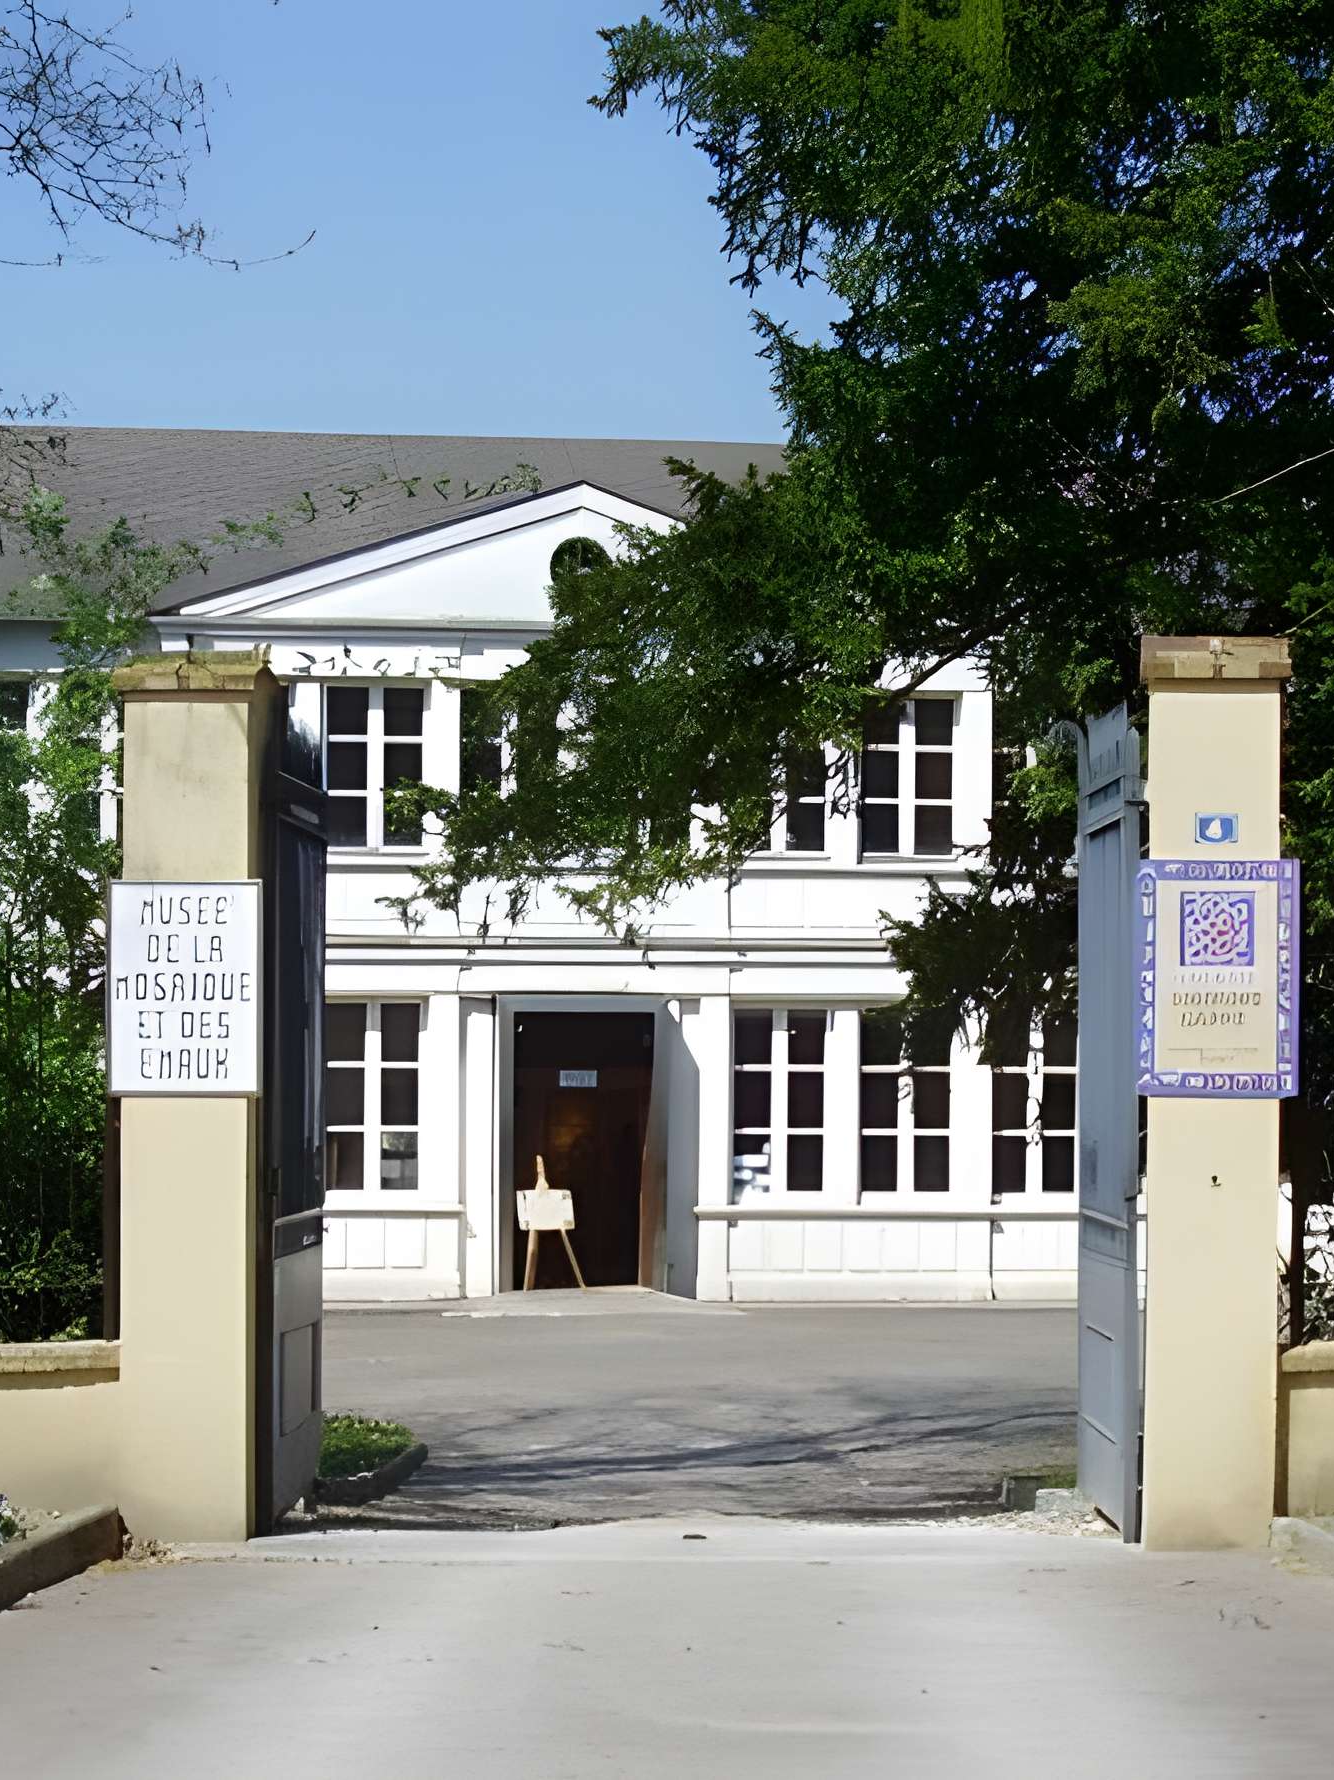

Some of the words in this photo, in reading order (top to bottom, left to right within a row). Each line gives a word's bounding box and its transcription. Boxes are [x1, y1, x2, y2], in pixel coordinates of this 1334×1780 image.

[147, 934, 179, 963] DE
[194, 935, 223, 963] LA
[138, 1010, 164, 1039] ET
[181, 1011, 229, 1039] DES
